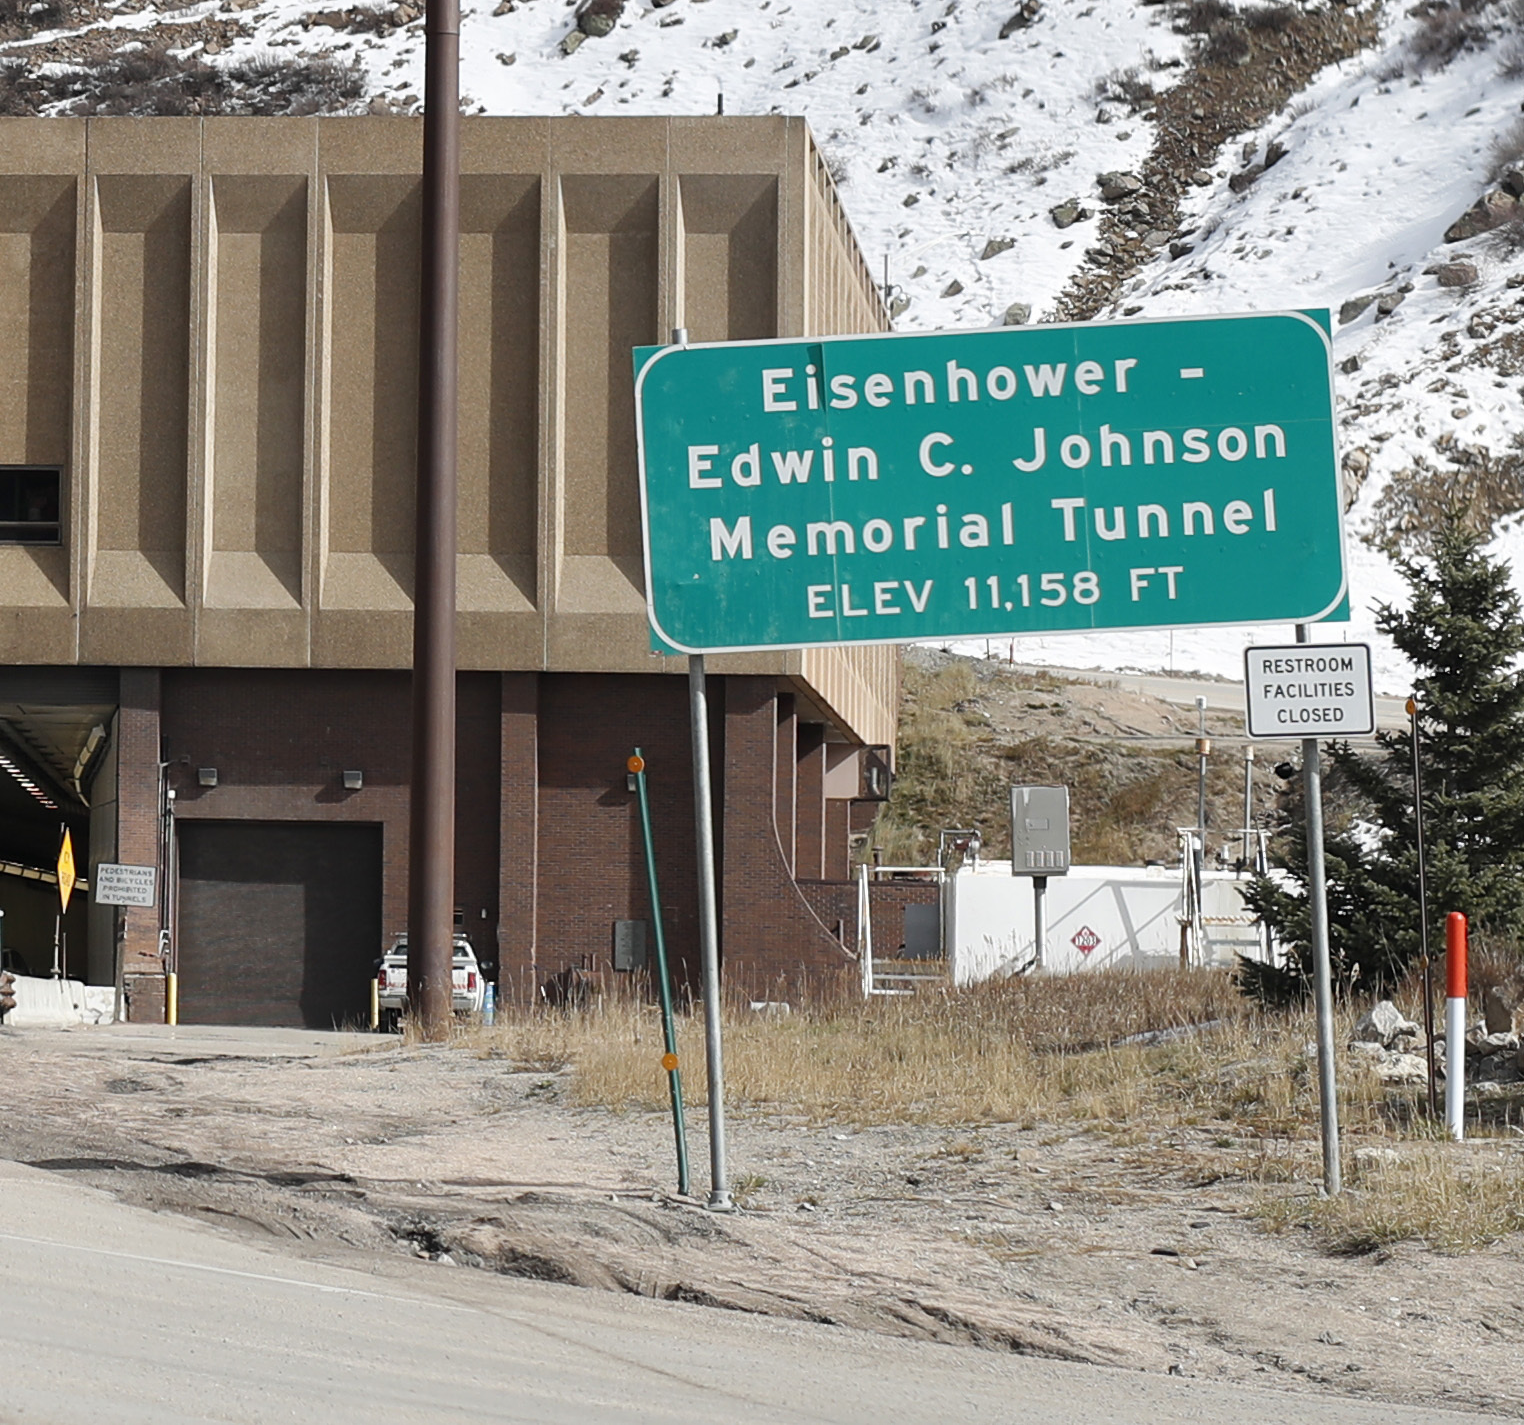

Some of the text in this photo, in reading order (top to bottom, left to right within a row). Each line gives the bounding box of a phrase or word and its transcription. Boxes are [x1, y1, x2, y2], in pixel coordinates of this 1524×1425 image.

[761, 358, 1205, 413] Eisenhower -
[687, 423, 1287, 489] Edwin C. Johnson
[709, 487, 1278, 561] Memorial Tunnel
[806, 565, 1184, 618] ELEV 11,158 FT
[1262, 657, 1354, 674] RESTROOM
[1263, 682, 1355, 699] FACILITIES
[1277, 707, 1344, 724] CLOSED
[100, 866, 153, 877] PEDESTRIANS
[102, 885, 148, 894] PROHIBITED
[116, 877, 154, 886] BICYCLES
[112, 894, 147, 903] TUNNELS
[1077, 936, 1096, 945] 1203
